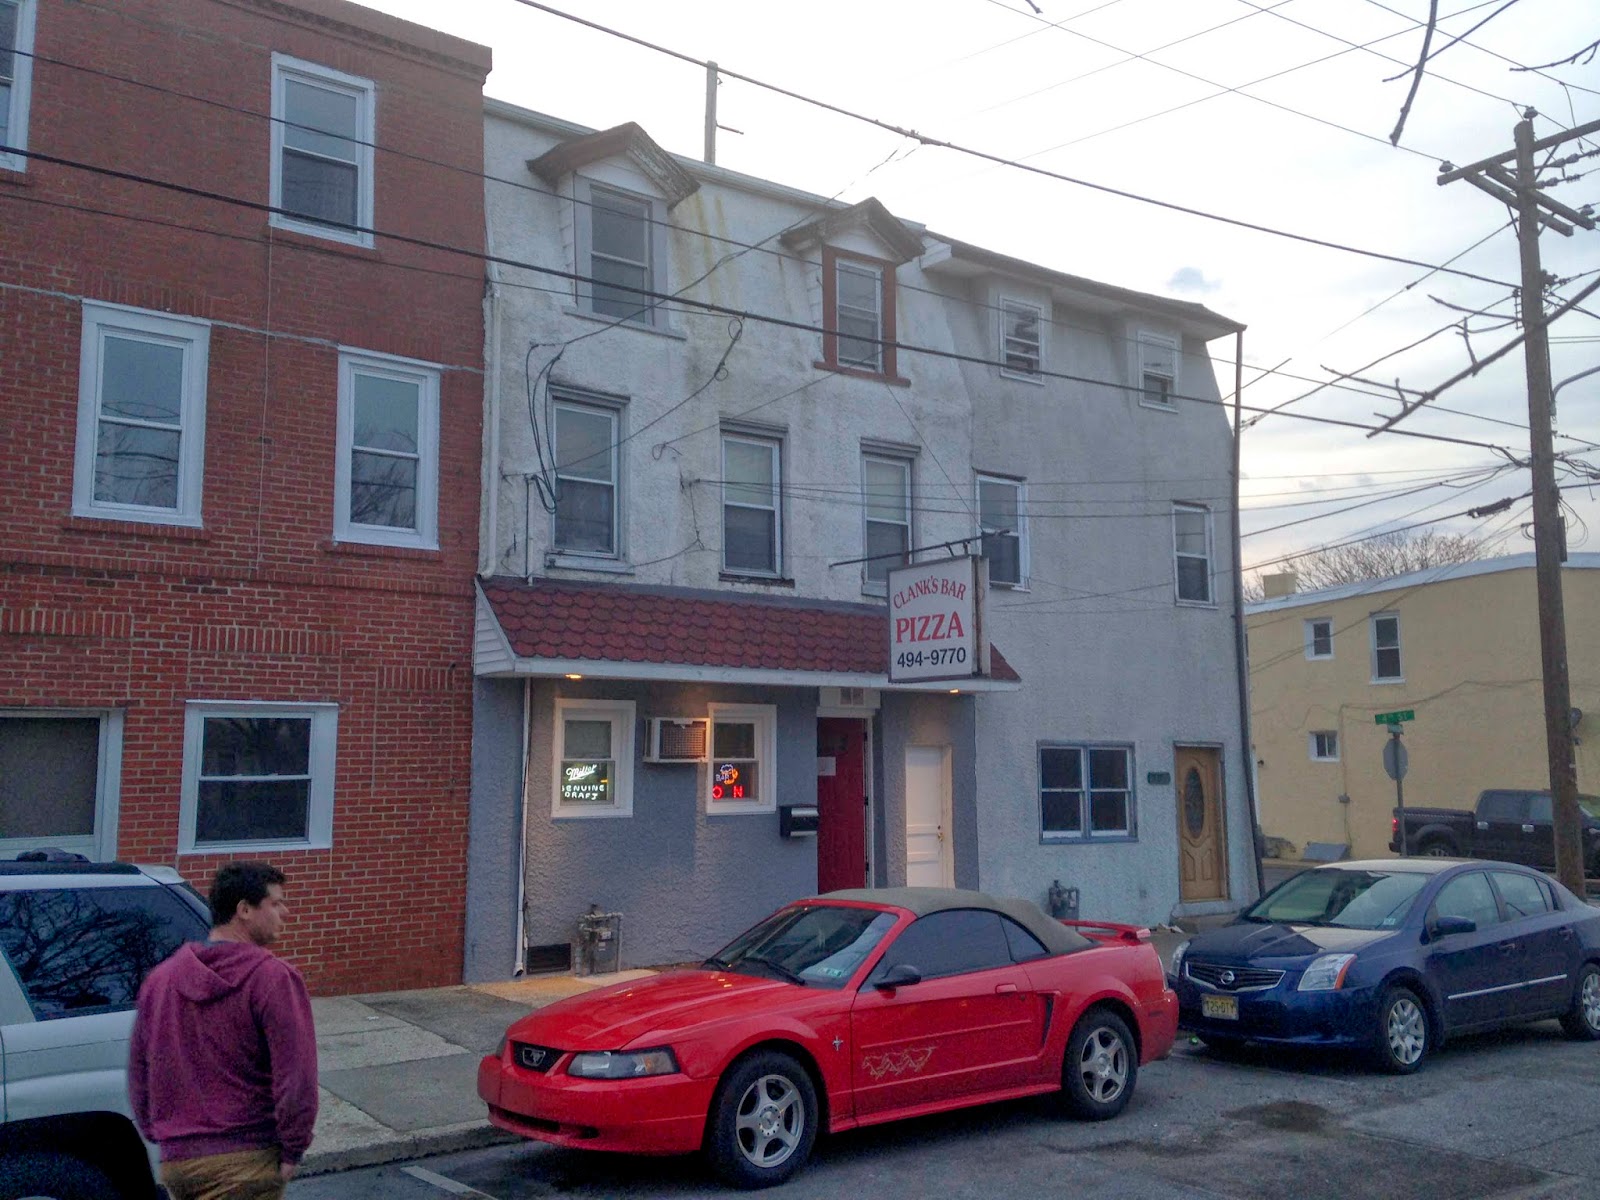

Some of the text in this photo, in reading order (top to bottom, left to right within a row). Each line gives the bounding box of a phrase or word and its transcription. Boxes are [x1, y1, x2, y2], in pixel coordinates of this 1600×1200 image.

[893, 575, 967, 609] CLANK'S BAR
[895, 611, 965, 644] PIZZA
[897, 647, 967, 668] 494-9770
